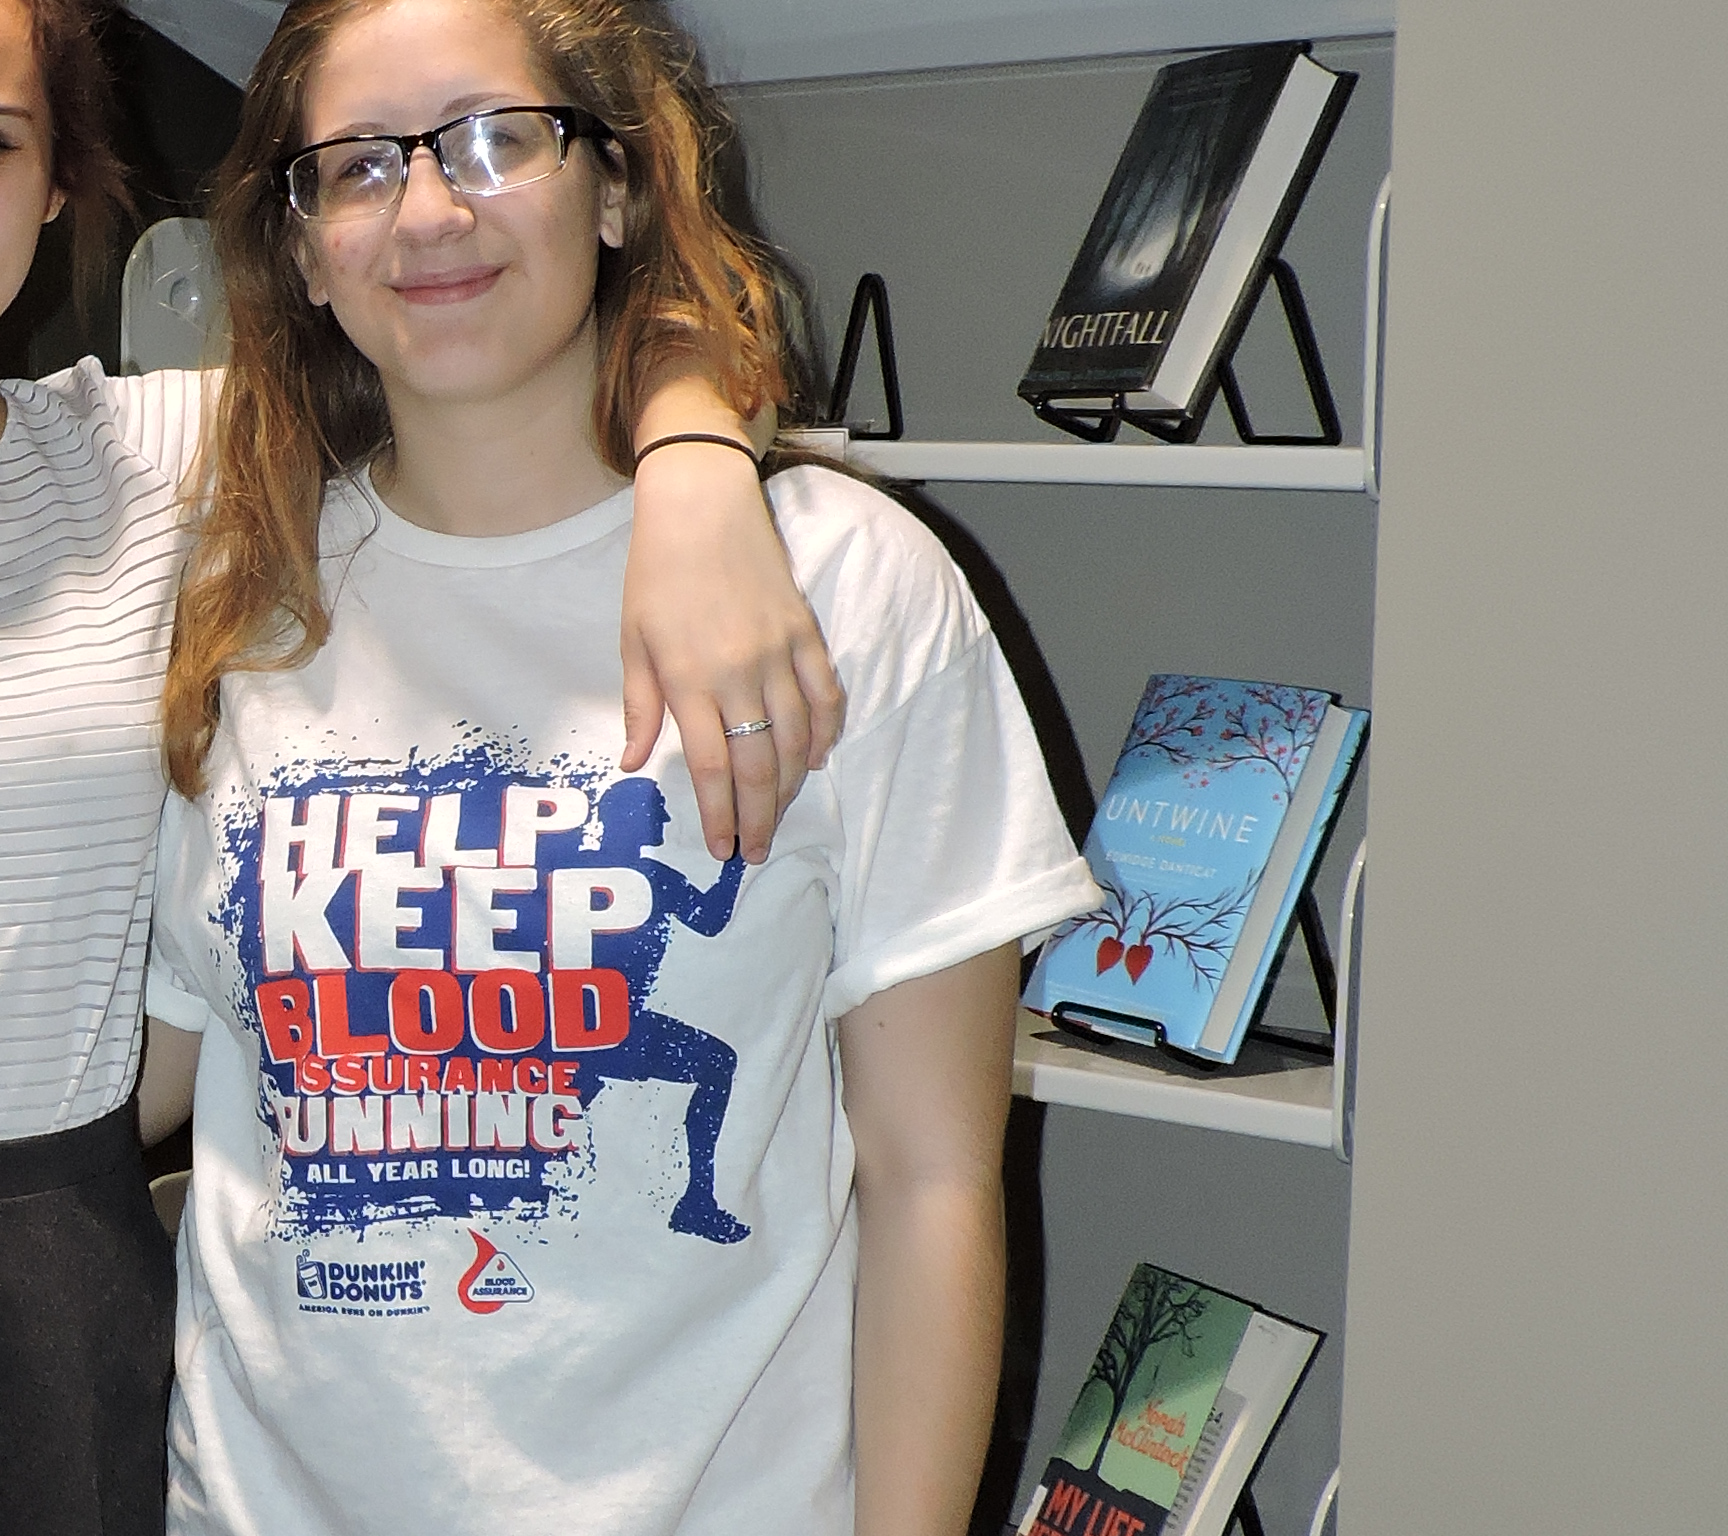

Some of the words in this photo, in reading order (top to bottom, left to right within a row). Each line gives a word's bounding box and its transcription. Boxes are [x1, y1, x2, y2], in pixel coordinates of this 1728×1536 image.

[262, 785, 591, 880] HELP
[1105, 793, 1259, 844] UNTWINE
[259, 865, 654, 976] KEEP
[254, 968, 630, 1064] BLOOD
[295, 1054, 582, 1097] SSURANCE
[306, 1163, 356, 1185] ALL
[366, 1159, 439, 1182] YEAR
[451, 1157, 530, 1179] LONG!
[329, 1280, 424, 1303] DONUTS
[484, 1277, 516, 1287] BLOOD
[1043, 1478, 1091, 1534] MY
